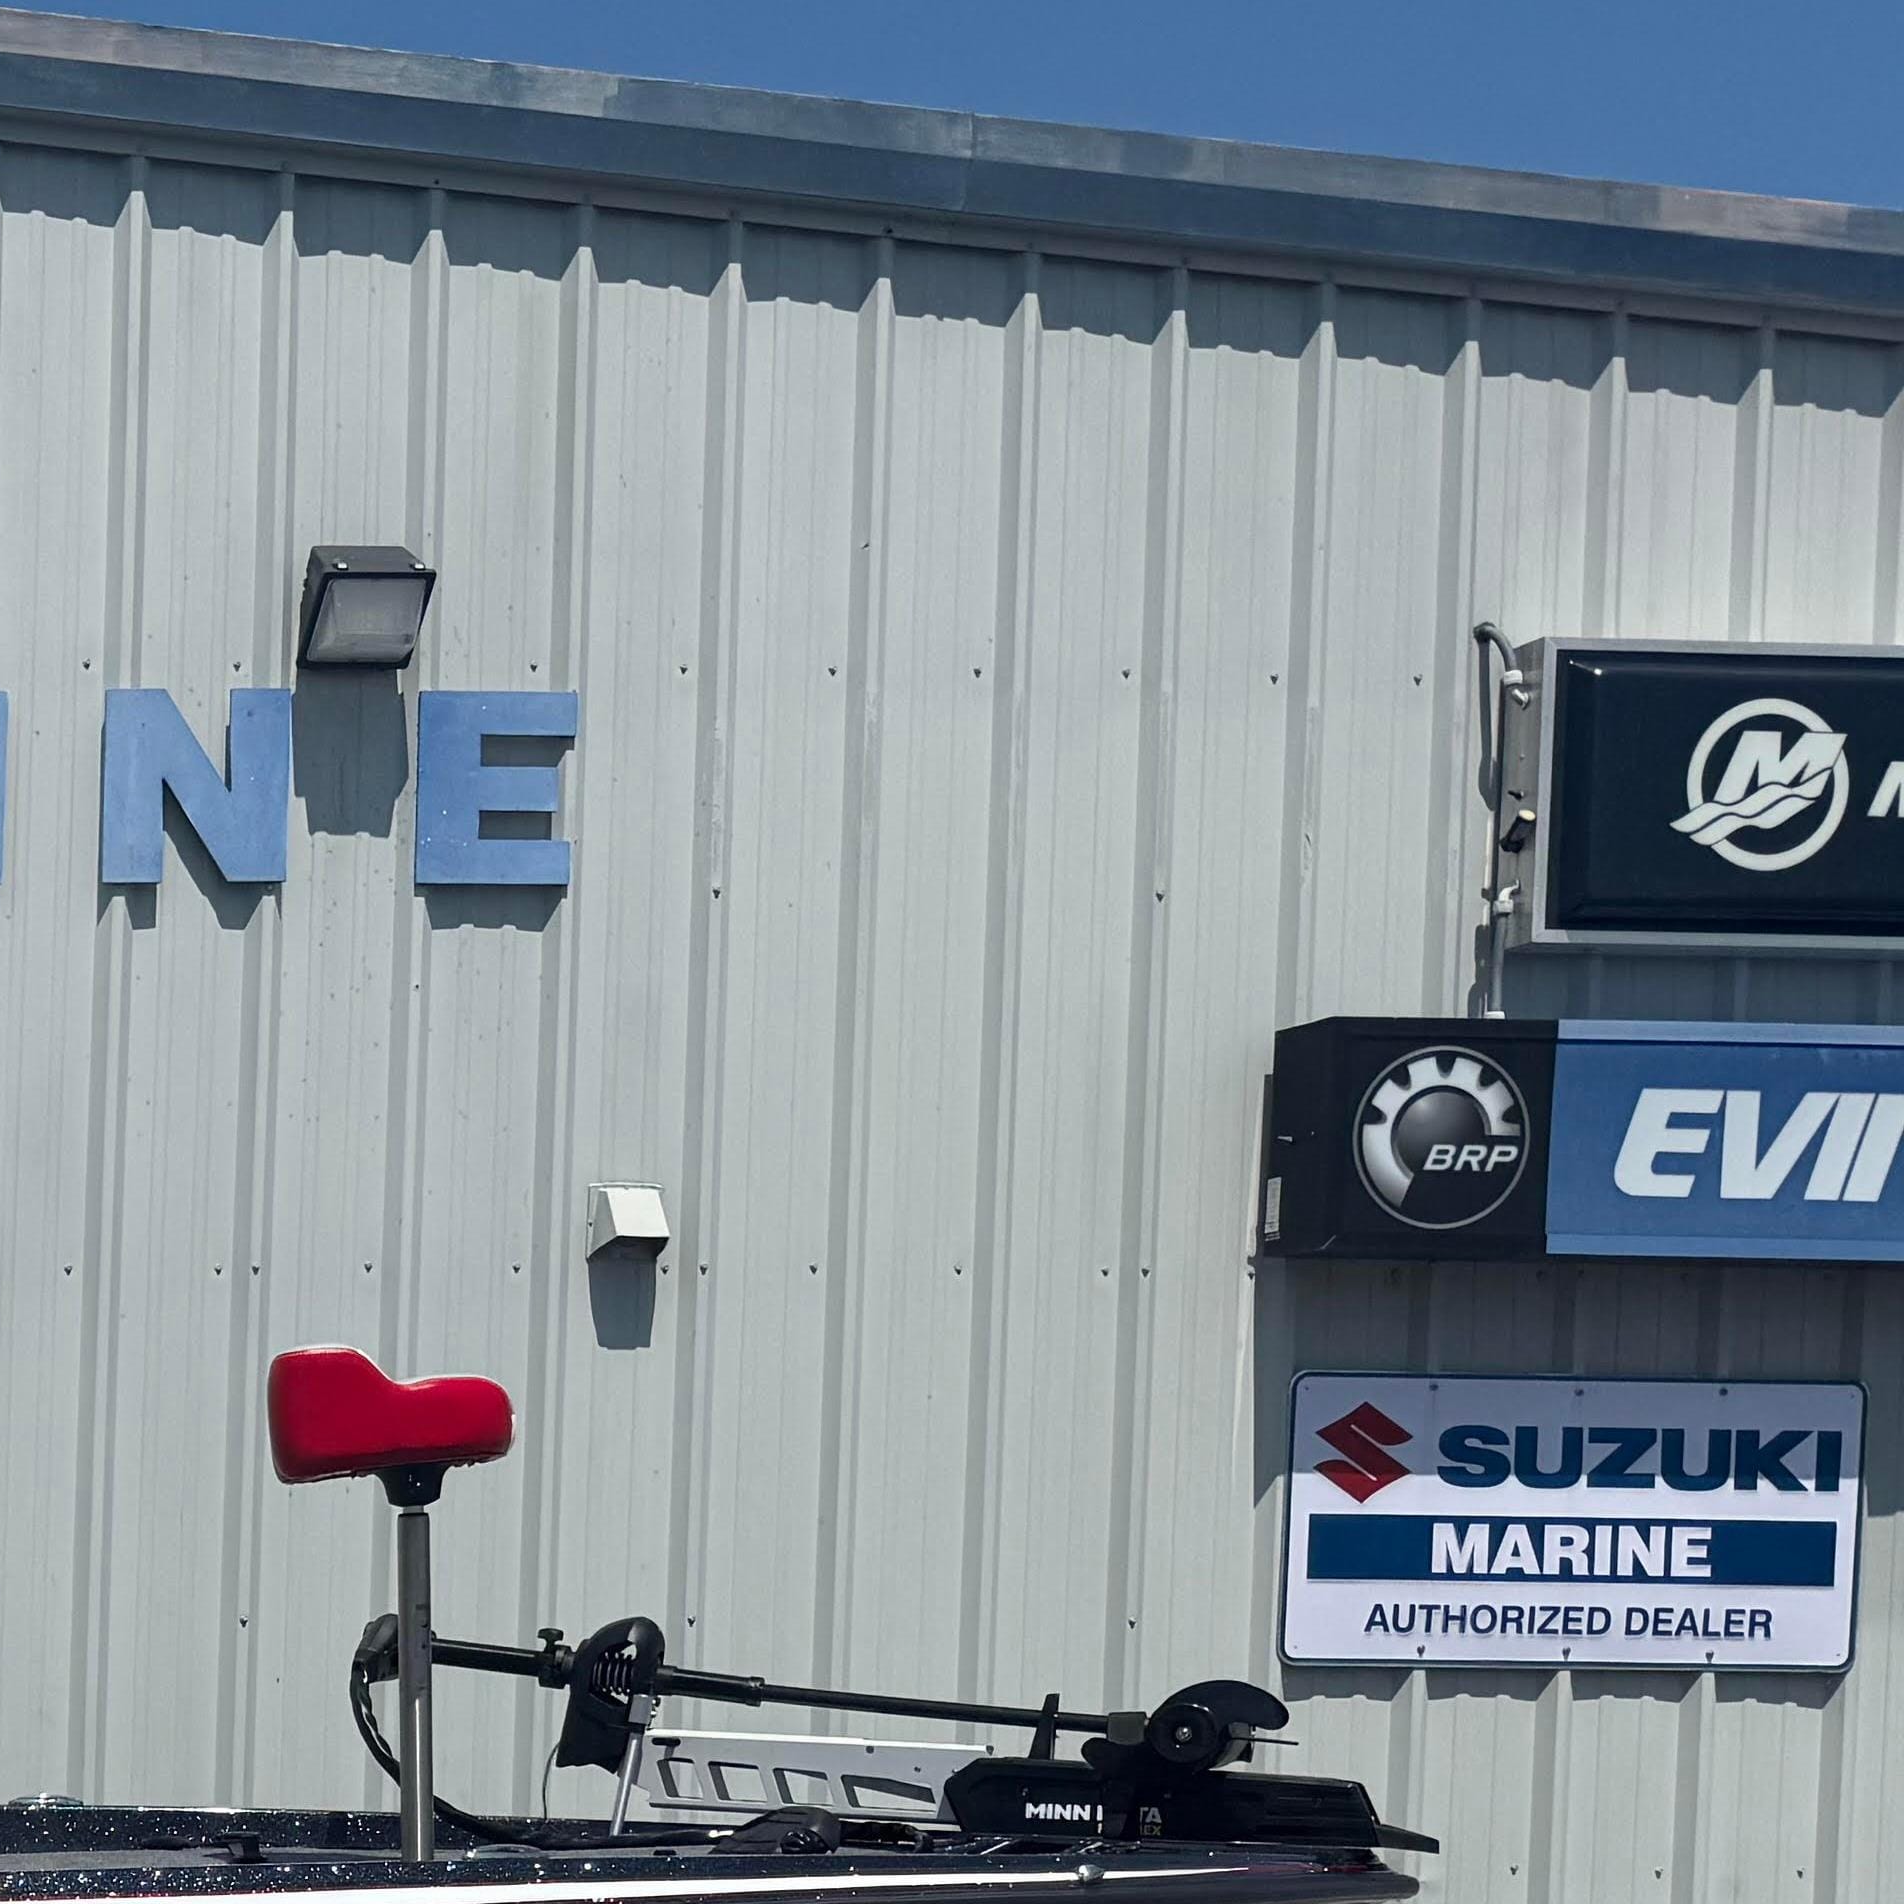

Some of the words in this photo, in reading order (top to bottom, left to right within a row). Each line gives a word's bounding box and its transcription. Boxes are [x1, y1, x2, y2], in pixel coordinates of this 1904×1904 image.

[1423, 1143, 1520, 1173] BRP
[1437, 1424, 1843, 1493] SUZUKI
[1430, 1523, 1713, 1579] MARINE
[1363, 1603, 1612, 1637] AUTHORIZED
[1624, 1606, 1773, 1640] DEALER
[1025, 1803, 1091, 1822] MINN
